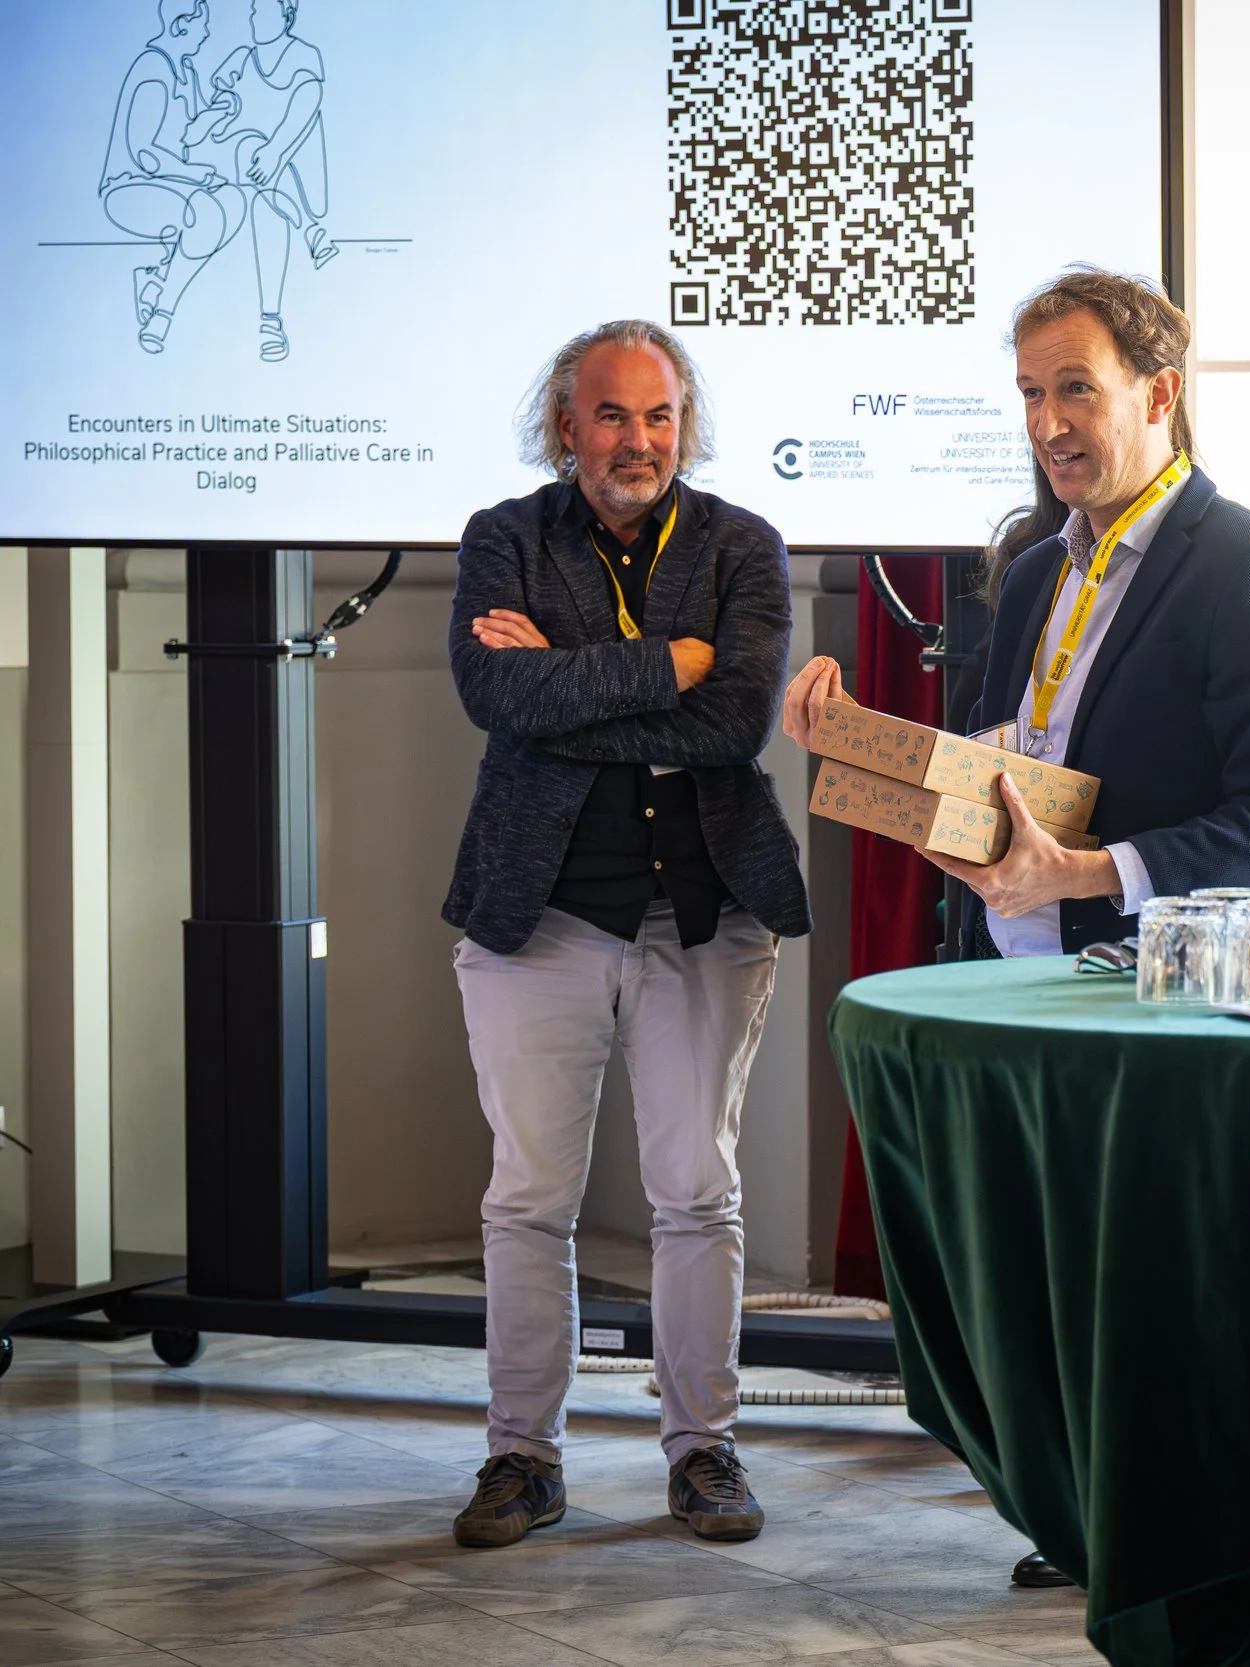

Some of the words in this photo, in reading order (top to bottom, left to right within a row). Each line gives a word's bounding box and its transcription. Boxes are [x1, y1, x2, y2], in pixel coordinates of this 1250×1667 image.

[853, 394, 907, 416] FWF
[913, 407, 1002, 416] Wissenschaftsfonds
[68, 414, 173, 433] Encounters
[178, 414, 195, 433] in
[201, 414, 281, 433] Ultimate
[286, 414, 388, 433] Situations:
[808, 439, 860, 448] HOCHSCHULE
[24, 442, 146, 464] Philosophical
[152, 443, 227, 461] Practice
[233, 443, 268, 461] and
[274, 443, 360, 462] Palliative
[366, 443, 411, 462] Care
[416, 443, 434, 462] in
[808, 450, 842, 458] CAMPUS
[844, 450, 866, 458] WIEN
[940, 447, 996, 459] UNIVERSITY
[999, 447, 1013, 459] OF
[808, 460, 851, 468] UNIVERSITY
[910, 465, 941, 473] Zentrum
[943, 465, 953, 473] für
[808, 470, 839, 479] APPLIED
[840, 470, 875, 479] SCIENCES
[197, 471, 257, 493] Dialog
[968, 476, 982, 484] und
[1070, 604, 1087, 638] UNIVERSITÄT
[1083, 588, 1093, 605] GRAZ
